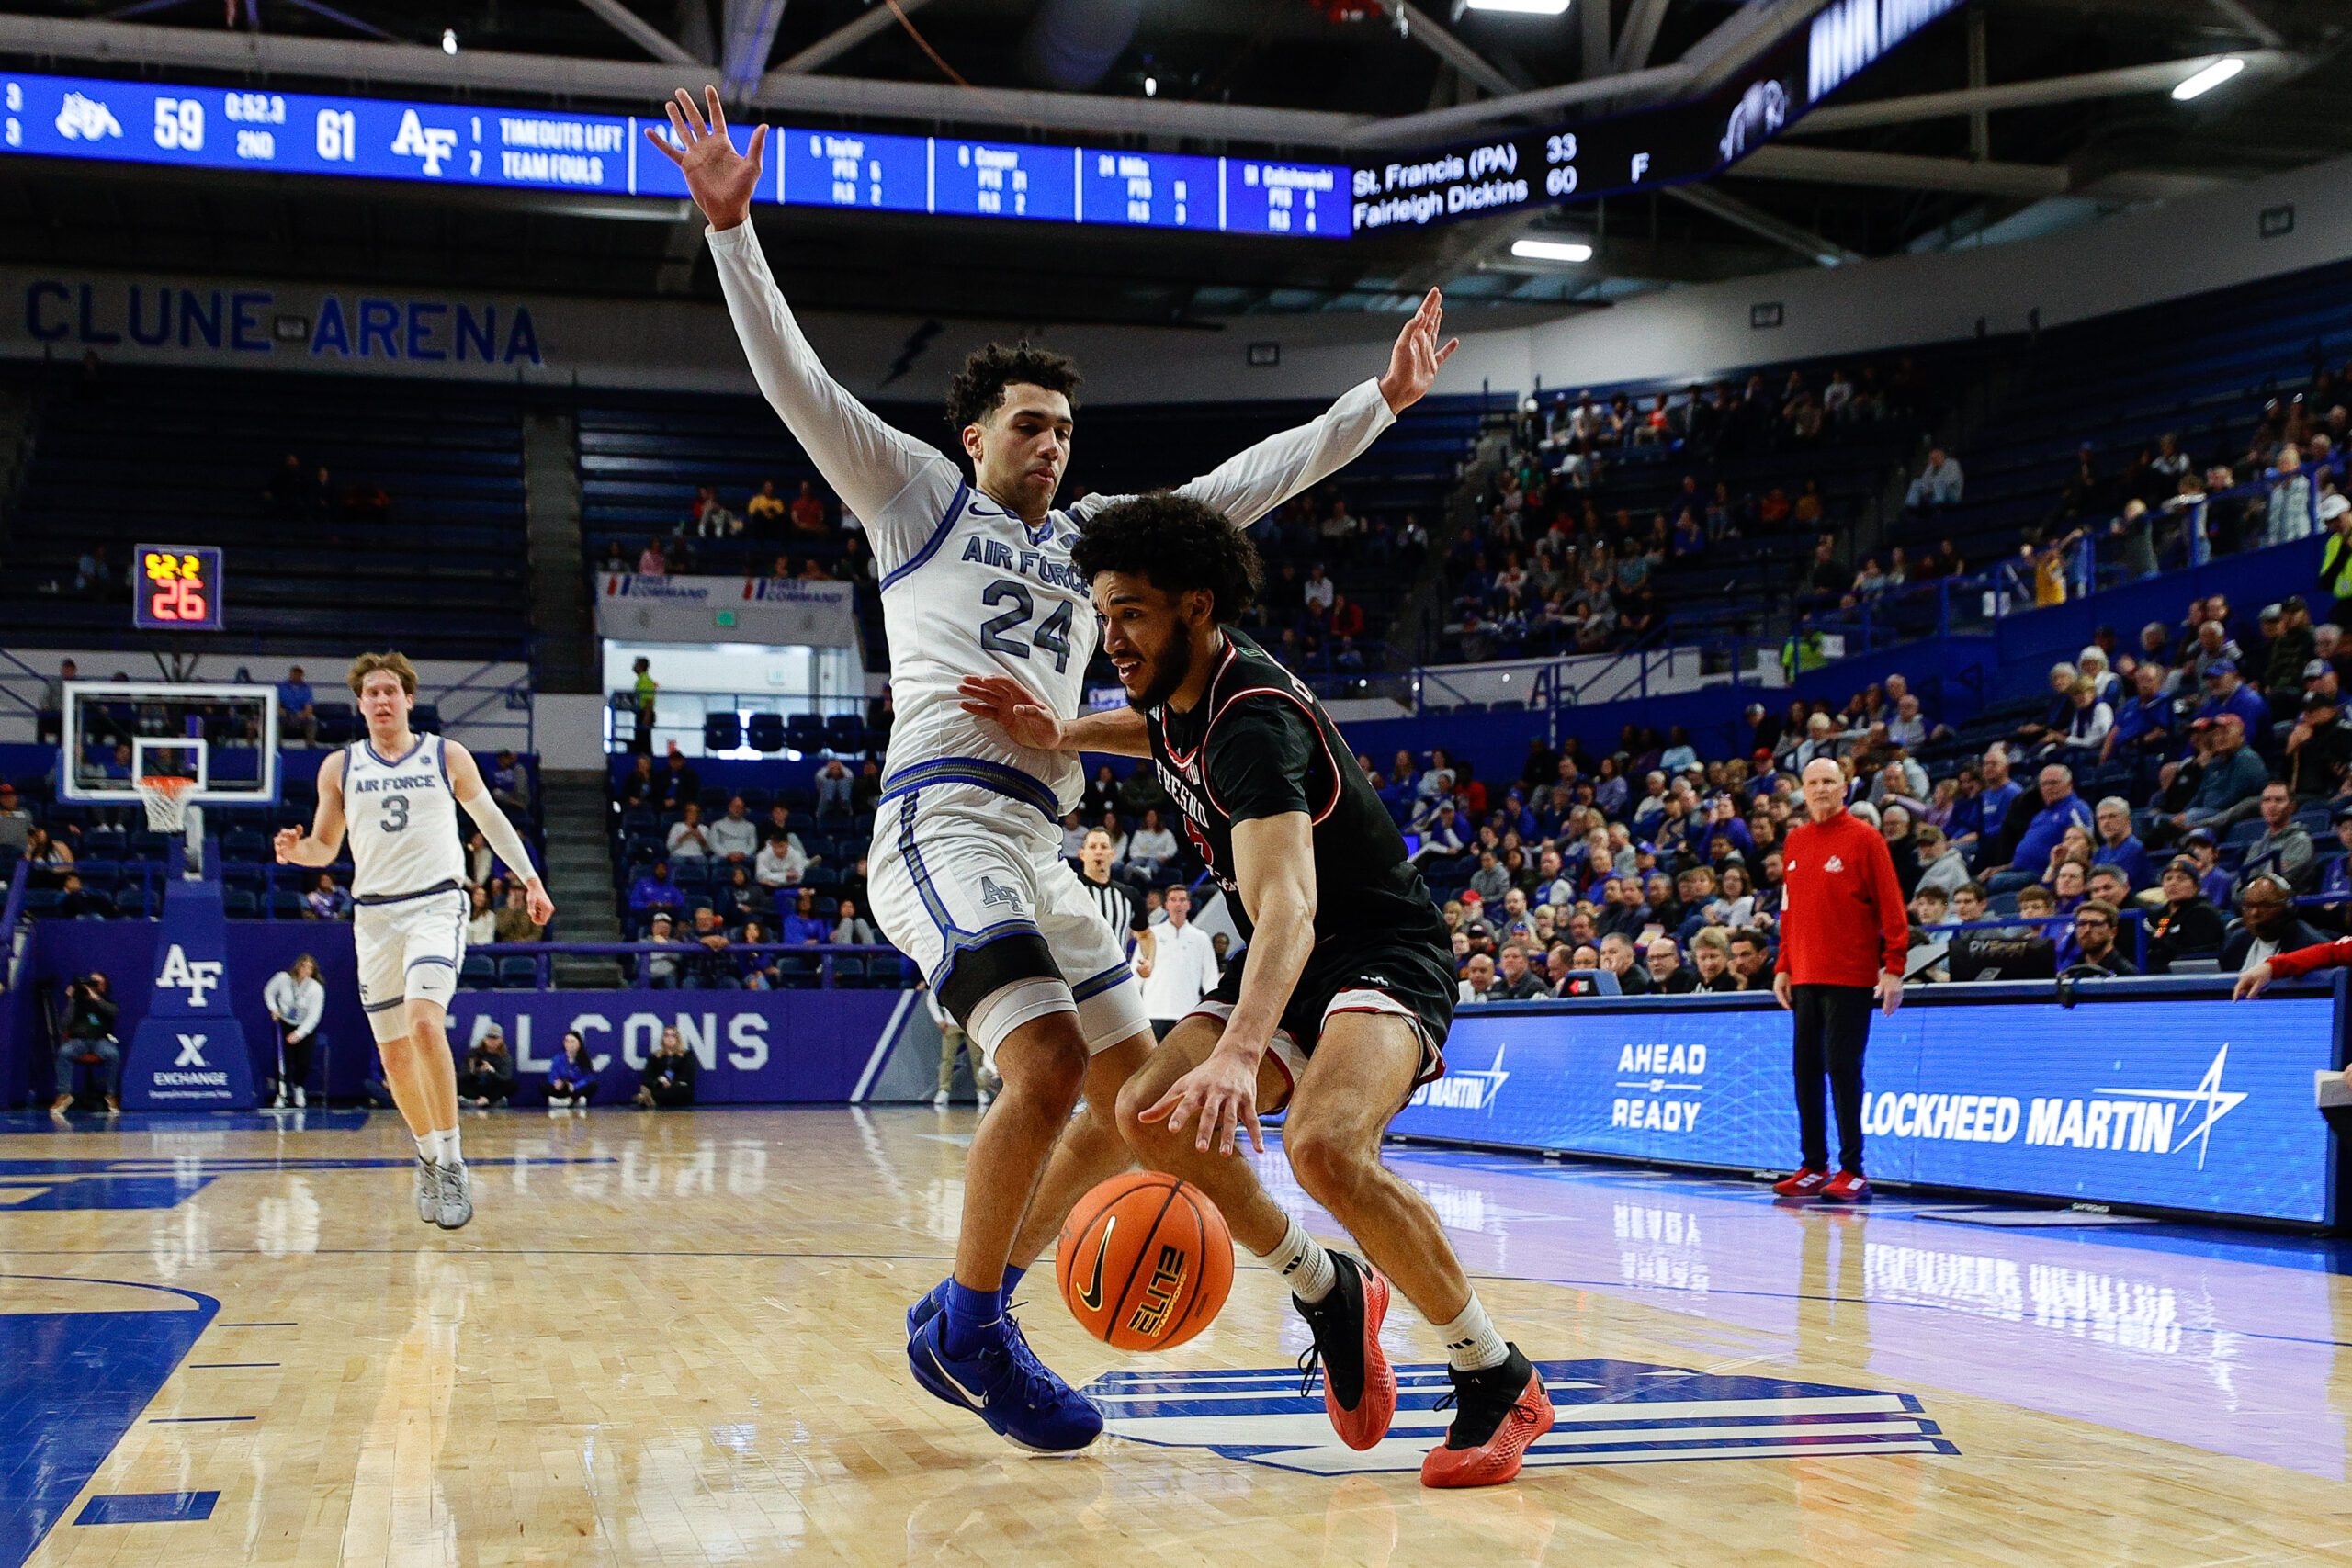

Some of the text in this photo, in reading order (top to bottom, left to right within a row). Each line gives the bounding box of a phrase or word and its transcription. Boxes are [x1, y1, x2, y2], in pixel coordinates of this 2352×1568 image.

[154, 96, 204, 152] 59
[236, 129, 276, 161] 2ND
[316, 108, 356, 162] 61
[390, 108, 458, 176] AF
[499, 117, 583, 150] TIMEOUTS
[585, 123, 625, 153] LEFT
[501, 150, 548, 179] TEAM
[550, 154, 604, 185] FOULS
[1352, 169, 1382, 197] St.
[1385, 154, 1464, 193] Francis
[1469, 142, 1517, 181] (PA)
[1546, 132, 1577, 164] 33
[1631, 152, 1650, 184] F
[1352, 189, 1444, 230] Fairleigh
[1447, 178, 1529, 214] Dickins
[24, 279, 544, 365] CLUNE ARENA
[962, 536, 1091, 600] AIR FORCE
[152, 577, 206, 621] 26
[980, 579, 1073, 675] 24
[355, 774, 435, 794] AIR FORCE
[1155, 757, 1210, 829] FRESNO
[380, 795, 409, 832] 3
[155, 943, 223, 1007] AF
[175, 1033, 208, 1067] X
[445, 1013, 770, 1073] LCONS
[1617, 1043, 1707, 1075] AHEAD
[153, 1072, 228, 1086] EXCHANGE
[1427, 1077, 1485, 1110] MARTIN
[1611, 1098, 1702, 1133] READY
[1860, 1091, 2177, 1154] LOCKHEED MARTIN
[1126, 1244, 1185, 1336] ELITE
